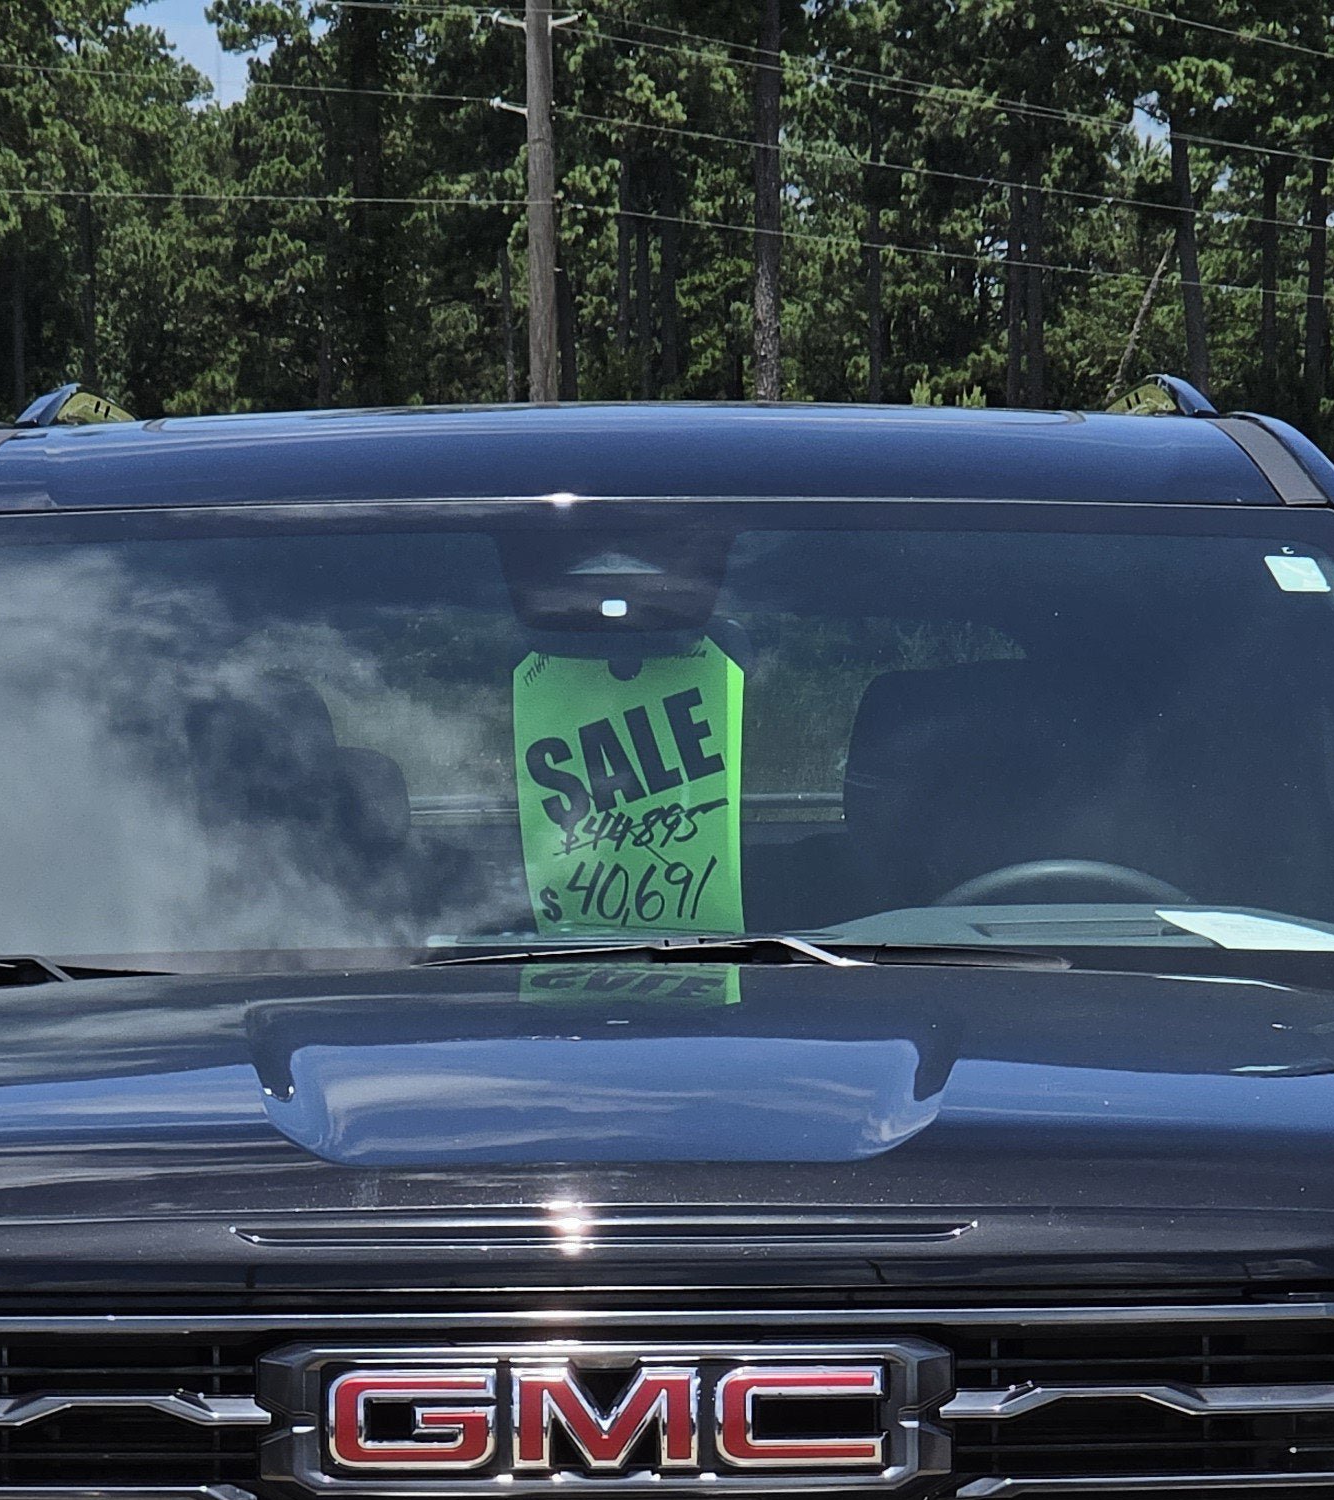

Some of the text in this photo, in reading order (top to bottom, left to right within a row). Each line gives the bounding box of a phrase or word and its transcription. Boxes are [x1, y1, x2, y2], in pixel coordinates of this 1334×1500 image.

[525, 687, 725, 828] SALE
[539, 855, 717, 926] $40,691
[328, 1366, 886, 1468] GMC
